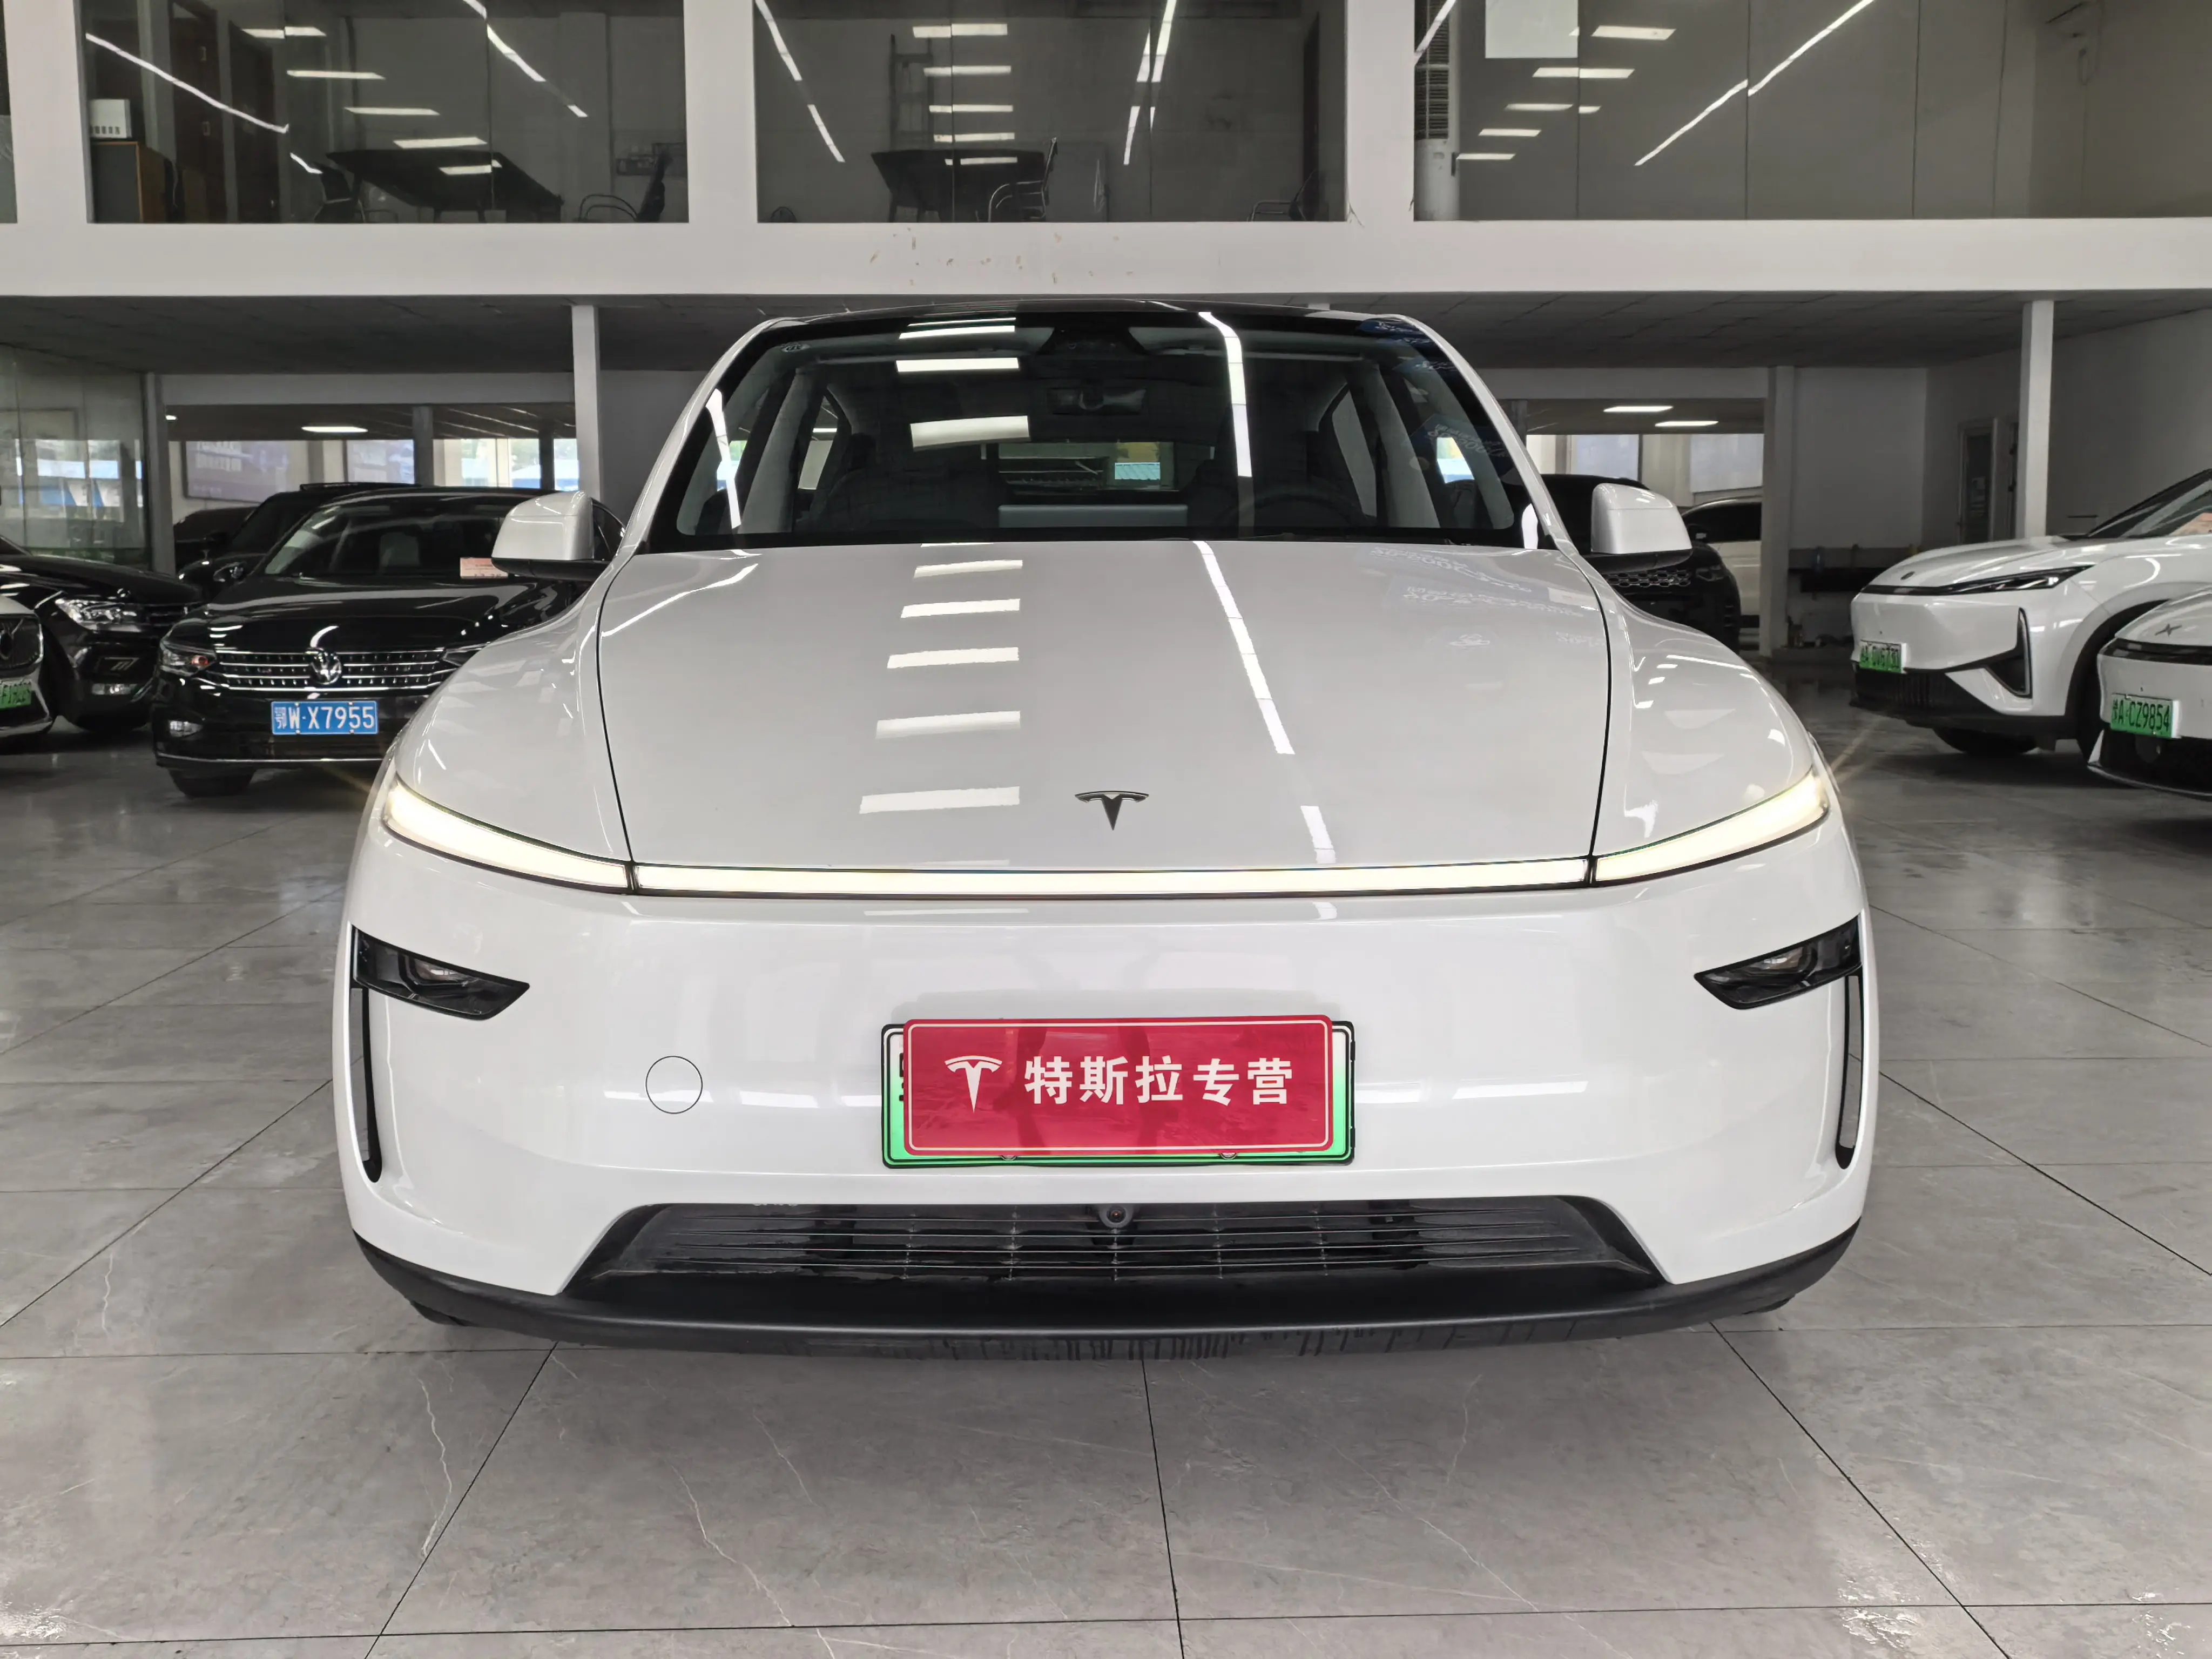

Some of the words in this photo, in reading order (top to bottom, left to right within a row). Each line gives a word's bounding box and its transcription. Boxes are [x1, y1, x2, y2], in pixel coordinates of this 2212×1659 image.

[1024, 1055, 1292, 1106] 特斯拉专营
